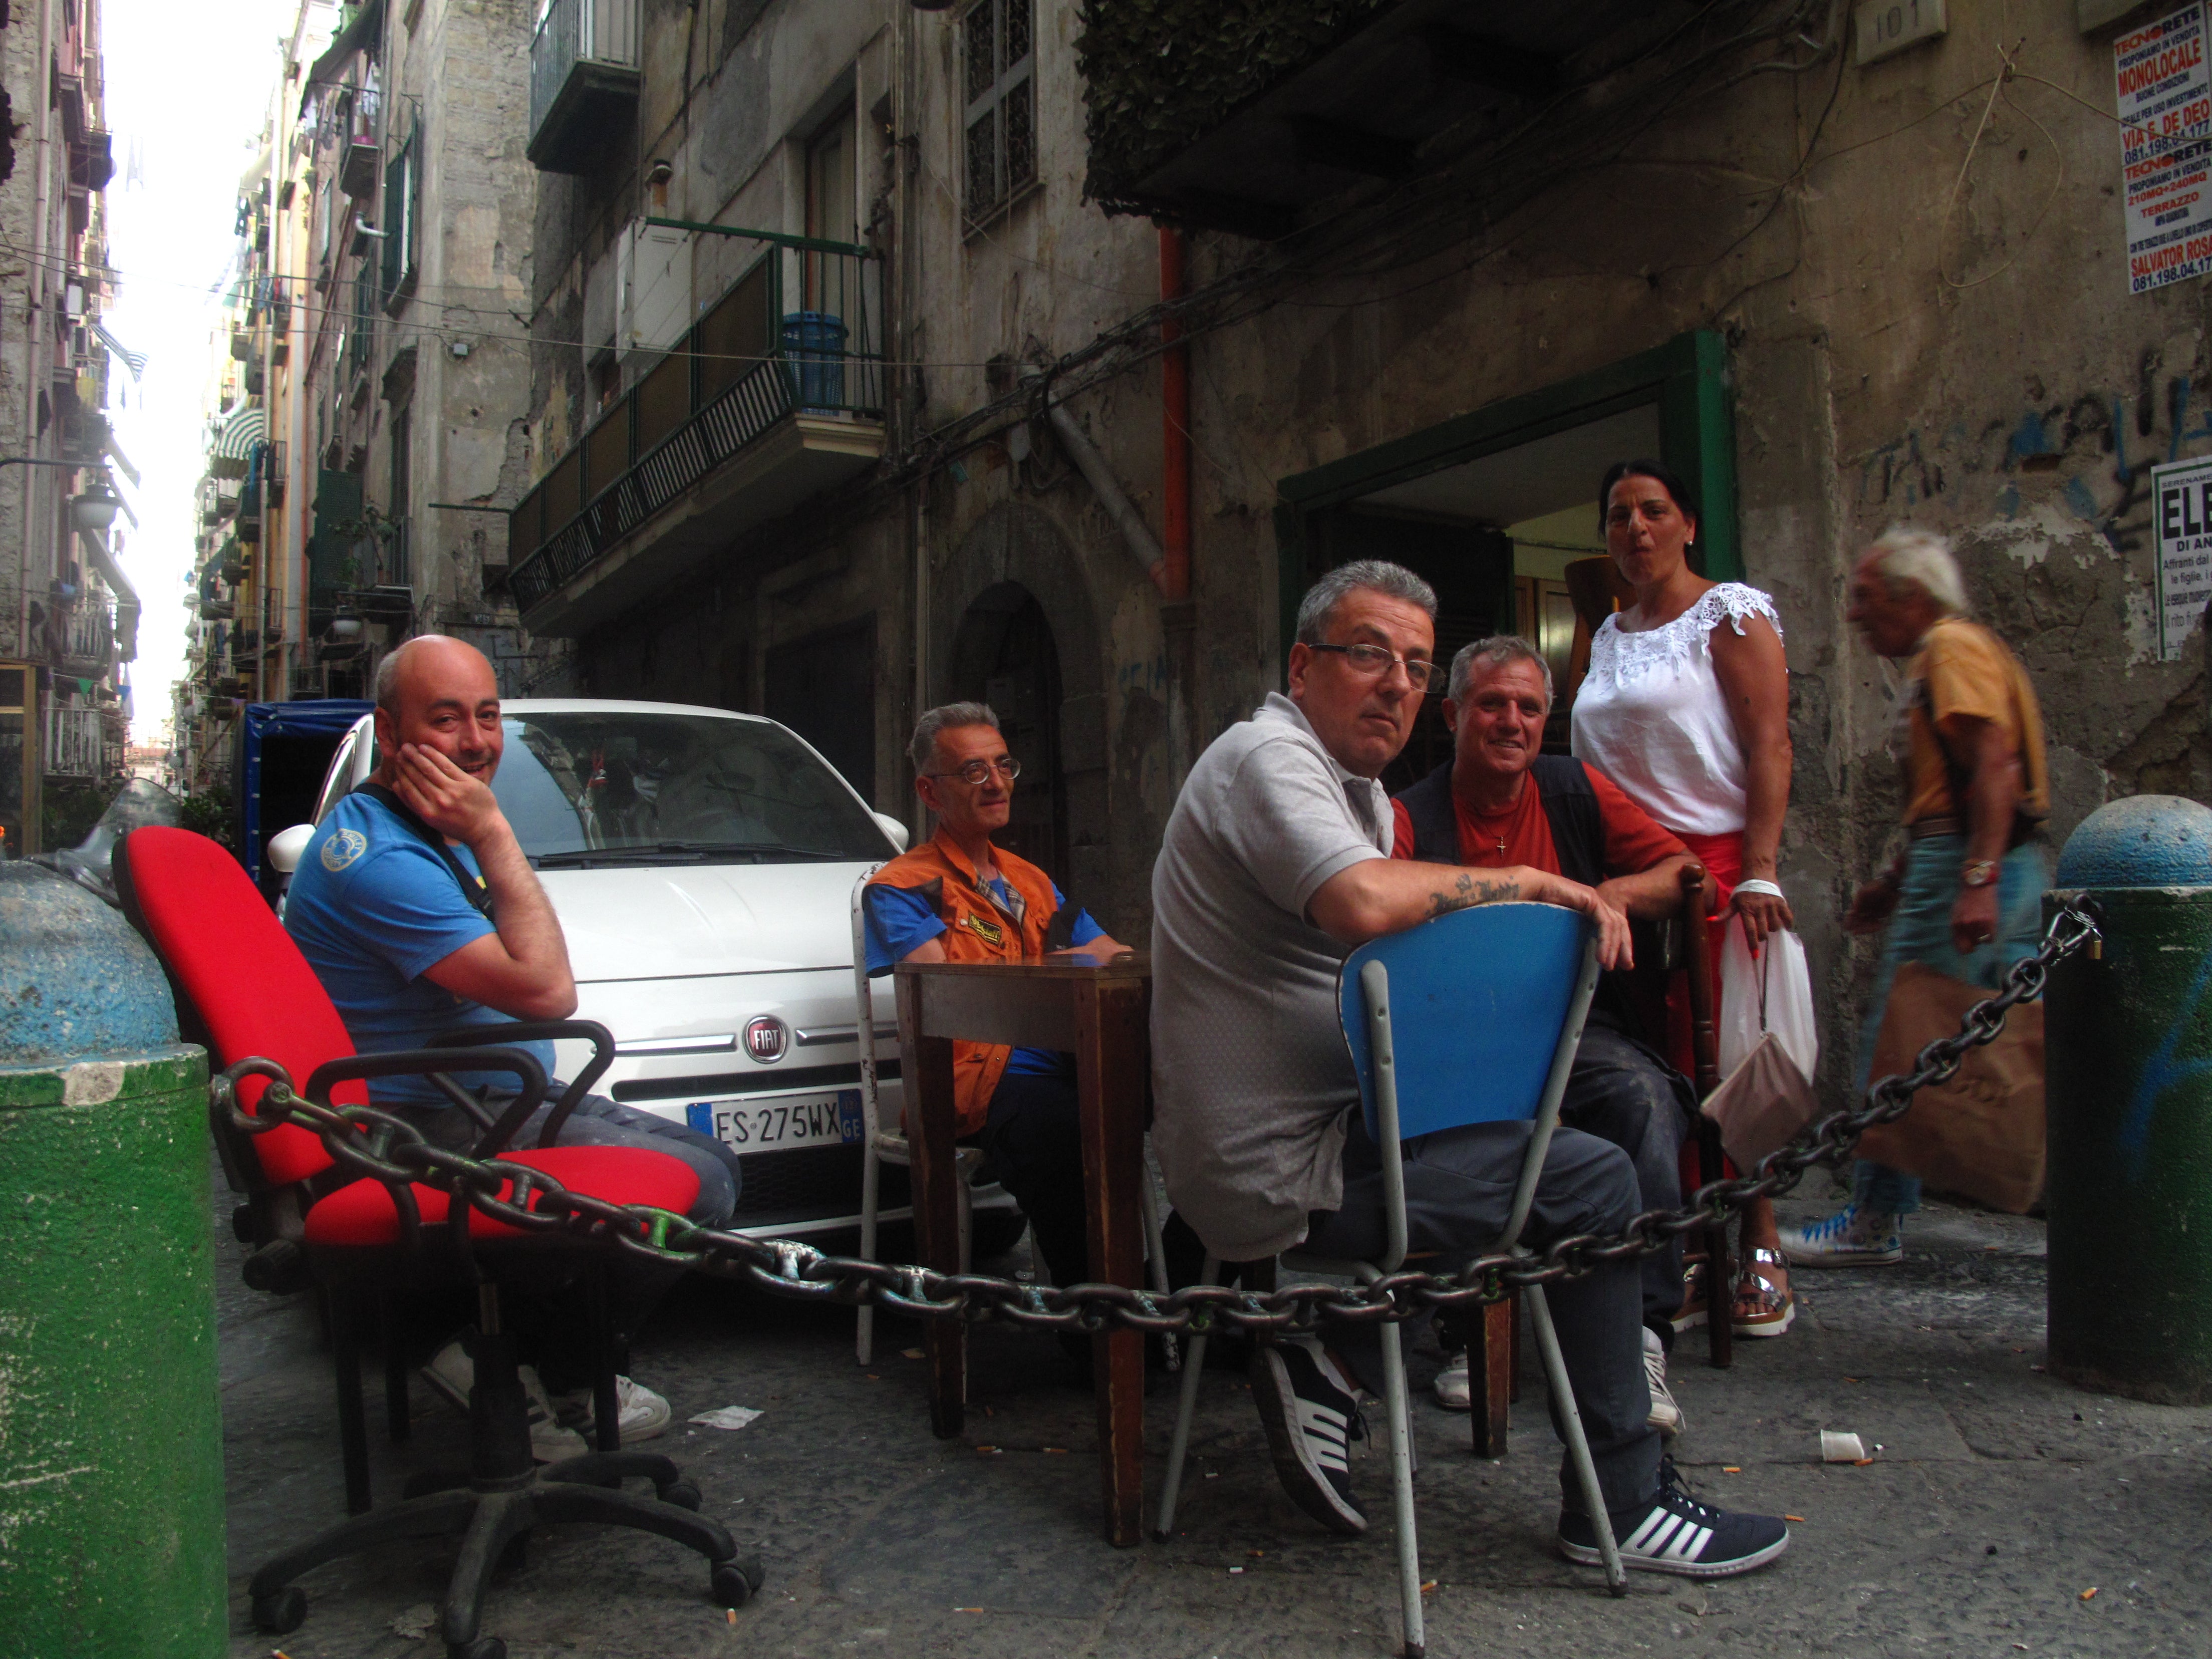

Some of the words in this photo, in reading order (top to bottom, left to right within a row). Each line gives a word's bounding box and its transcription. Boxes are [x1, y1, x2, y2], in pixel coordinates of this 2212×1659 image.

[2118, 43, 2161, 70] PROPONIAMO
[2162, 39, 2170, 50] IN
[2170, 25, 2200, 46] VENDITA
[2118, 37, 2202, 97] MONOLOCALE
[2141, 106, 2153, 118] PER
[2153, 101, 2165, 115] USO
[2122, 128, 2144, 150] VIA
[2162, 111, 2180, 135] DE
[2182, 98, 2210, 126] DEO
[2128, 171, 2172, 194] PROPONIAMO
[2173, 167, 2181, 179] IN
[2181, 157, 2211, 176] VENDITA
[2128, 171, 2207, 206] 210MQ+240MQ
[2140, 191, 2199, 218] TERRAZZO
[2131, 244, 2184, 278] SALVATOR
[2176, 539, 2189, 552] DI
[2163, 557, 2194, 570] Affranti
[2196, 554, 2209, 566] dal
[2171, 574, 2178, 584] le
[753, 1029, 779, 1050] FIAT
[843, 1119, 860, 1138] GE
